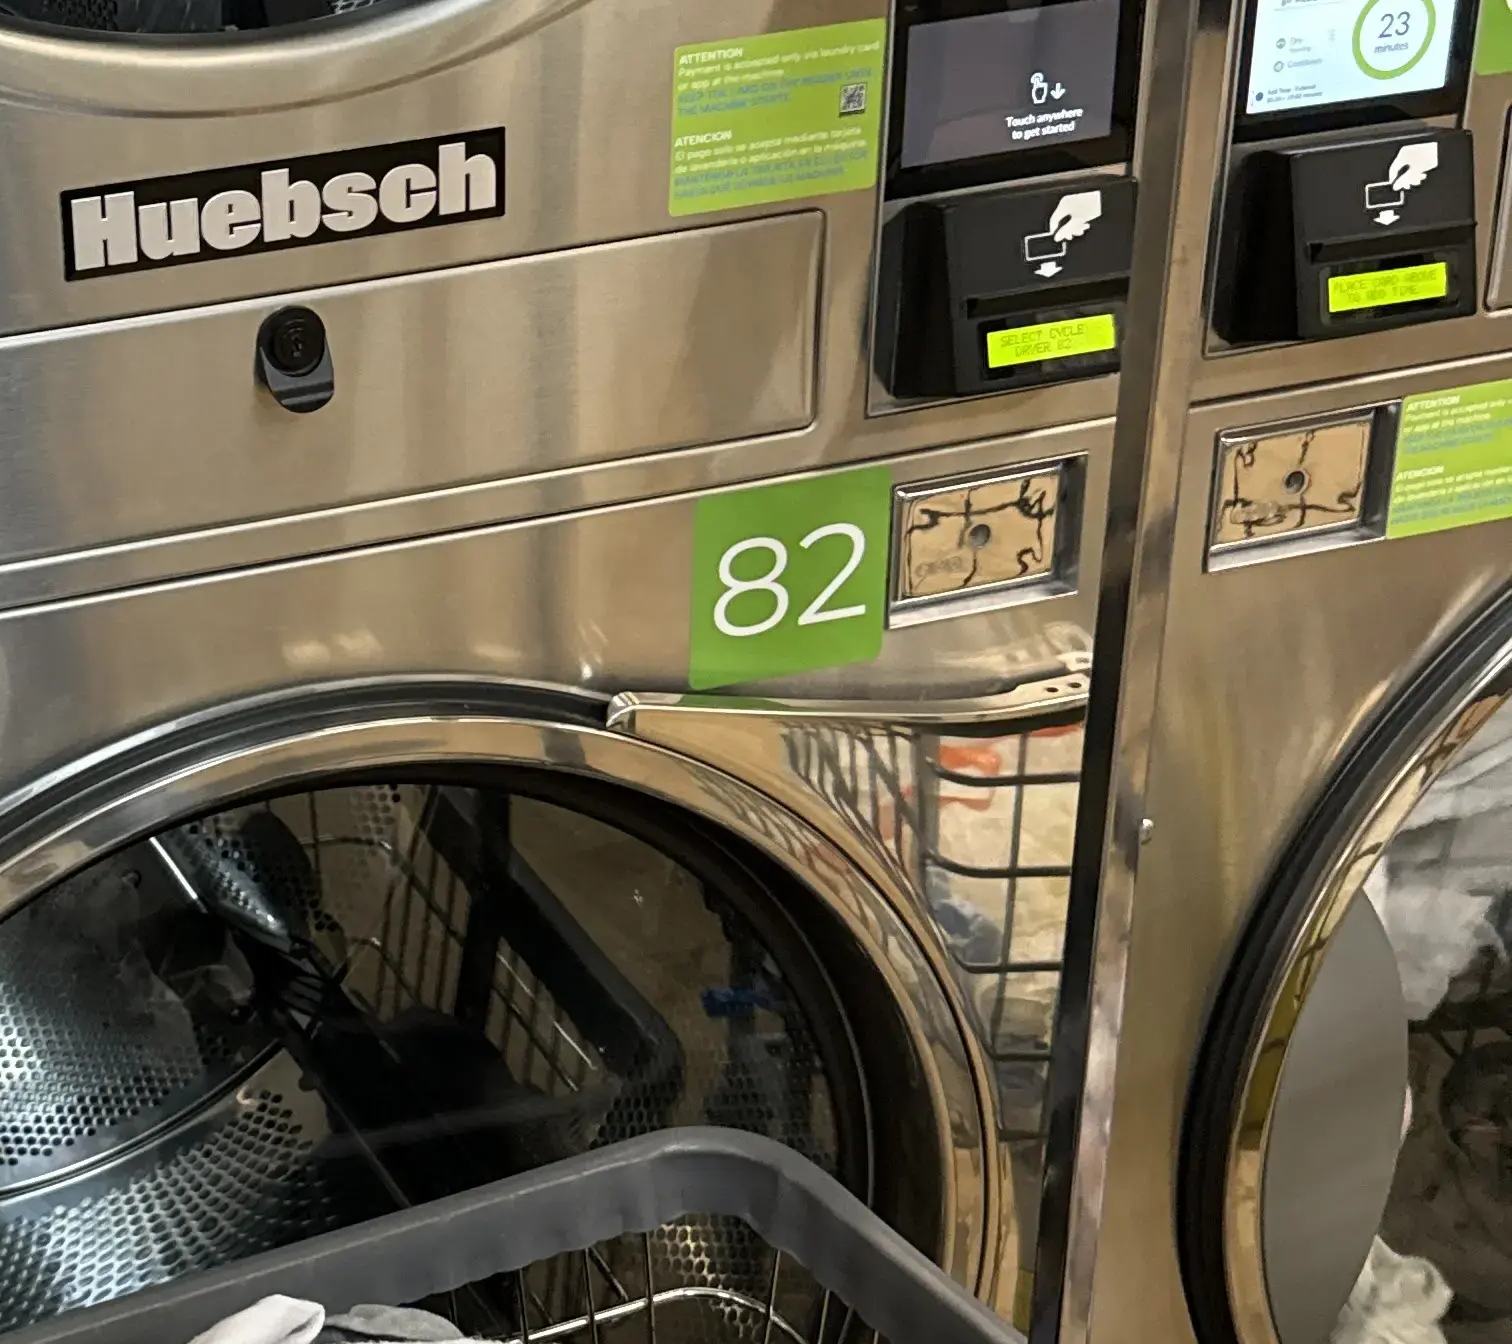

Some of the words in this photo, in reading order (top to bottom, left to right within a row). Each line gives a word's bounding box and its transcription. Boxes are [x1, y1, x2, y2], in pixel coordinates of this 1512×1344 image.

[1378, 11, 1411, 38] 23
[681, 47, 743, 65] ATTENTION
[1374, 41, 1408, 54] minutes
[1005, 114, 1035, 127] Touch
[1036, 109, 1083, 123] anywhere
[675, 130, 731, 147] ATENCION
[1012, 130, 1023, 140] to
[1024, 126, 1040, 140] get
[1042, 121, 1075, 135] started
[71, 142, 498, 272] Huebsch
[1000, 330, 1042, 347] SELECT
[1049, 324, 1085, 339] CYCLE
[1015, 341, 1051, 357] DRYER
[1057, 338, 1072, 350] 82
[1406, 395, 1460, 412] ATTENTION
[713, 521, 867, 639] 82
